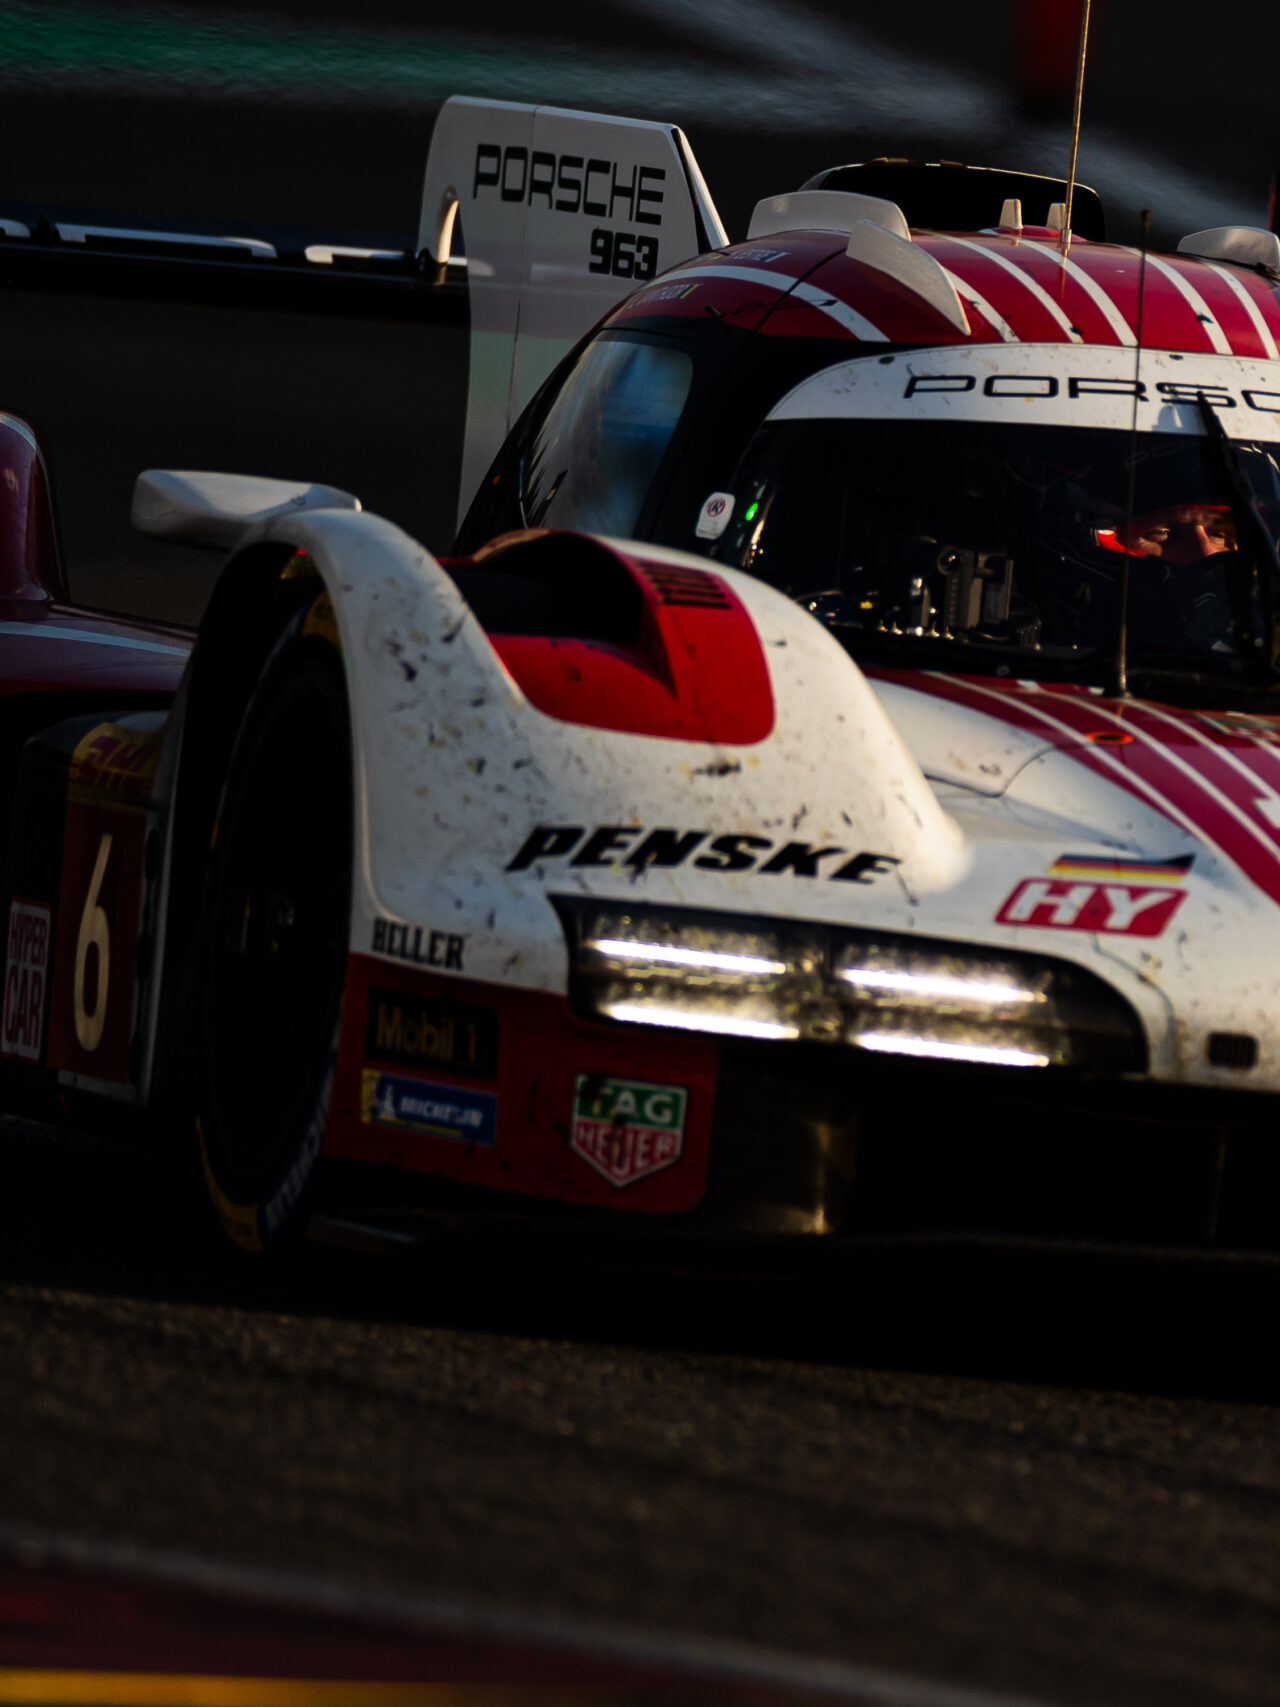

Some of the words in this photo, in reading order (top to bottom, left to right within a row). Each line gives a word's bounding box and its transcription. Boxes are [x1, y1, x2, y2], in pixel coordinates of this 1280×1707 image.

[473, 144, 666, 226] PORSCHE
[589, 229, 659, 280] 963
[506, 827, 901, 884] PENSKE
[1004, 881, 1174, 932] HY
[9, 911, 48, 968] HYPER
[73, 831, 114, 1053] 6
[371, 917, 464, 970] HELLER
[4, 964, 42, 1048] CAR
[375, 1001, 456, 1062] Mobil
[466, 1020, 479, 1065] 1
[577, 1122, 677, 1176] HEUER
